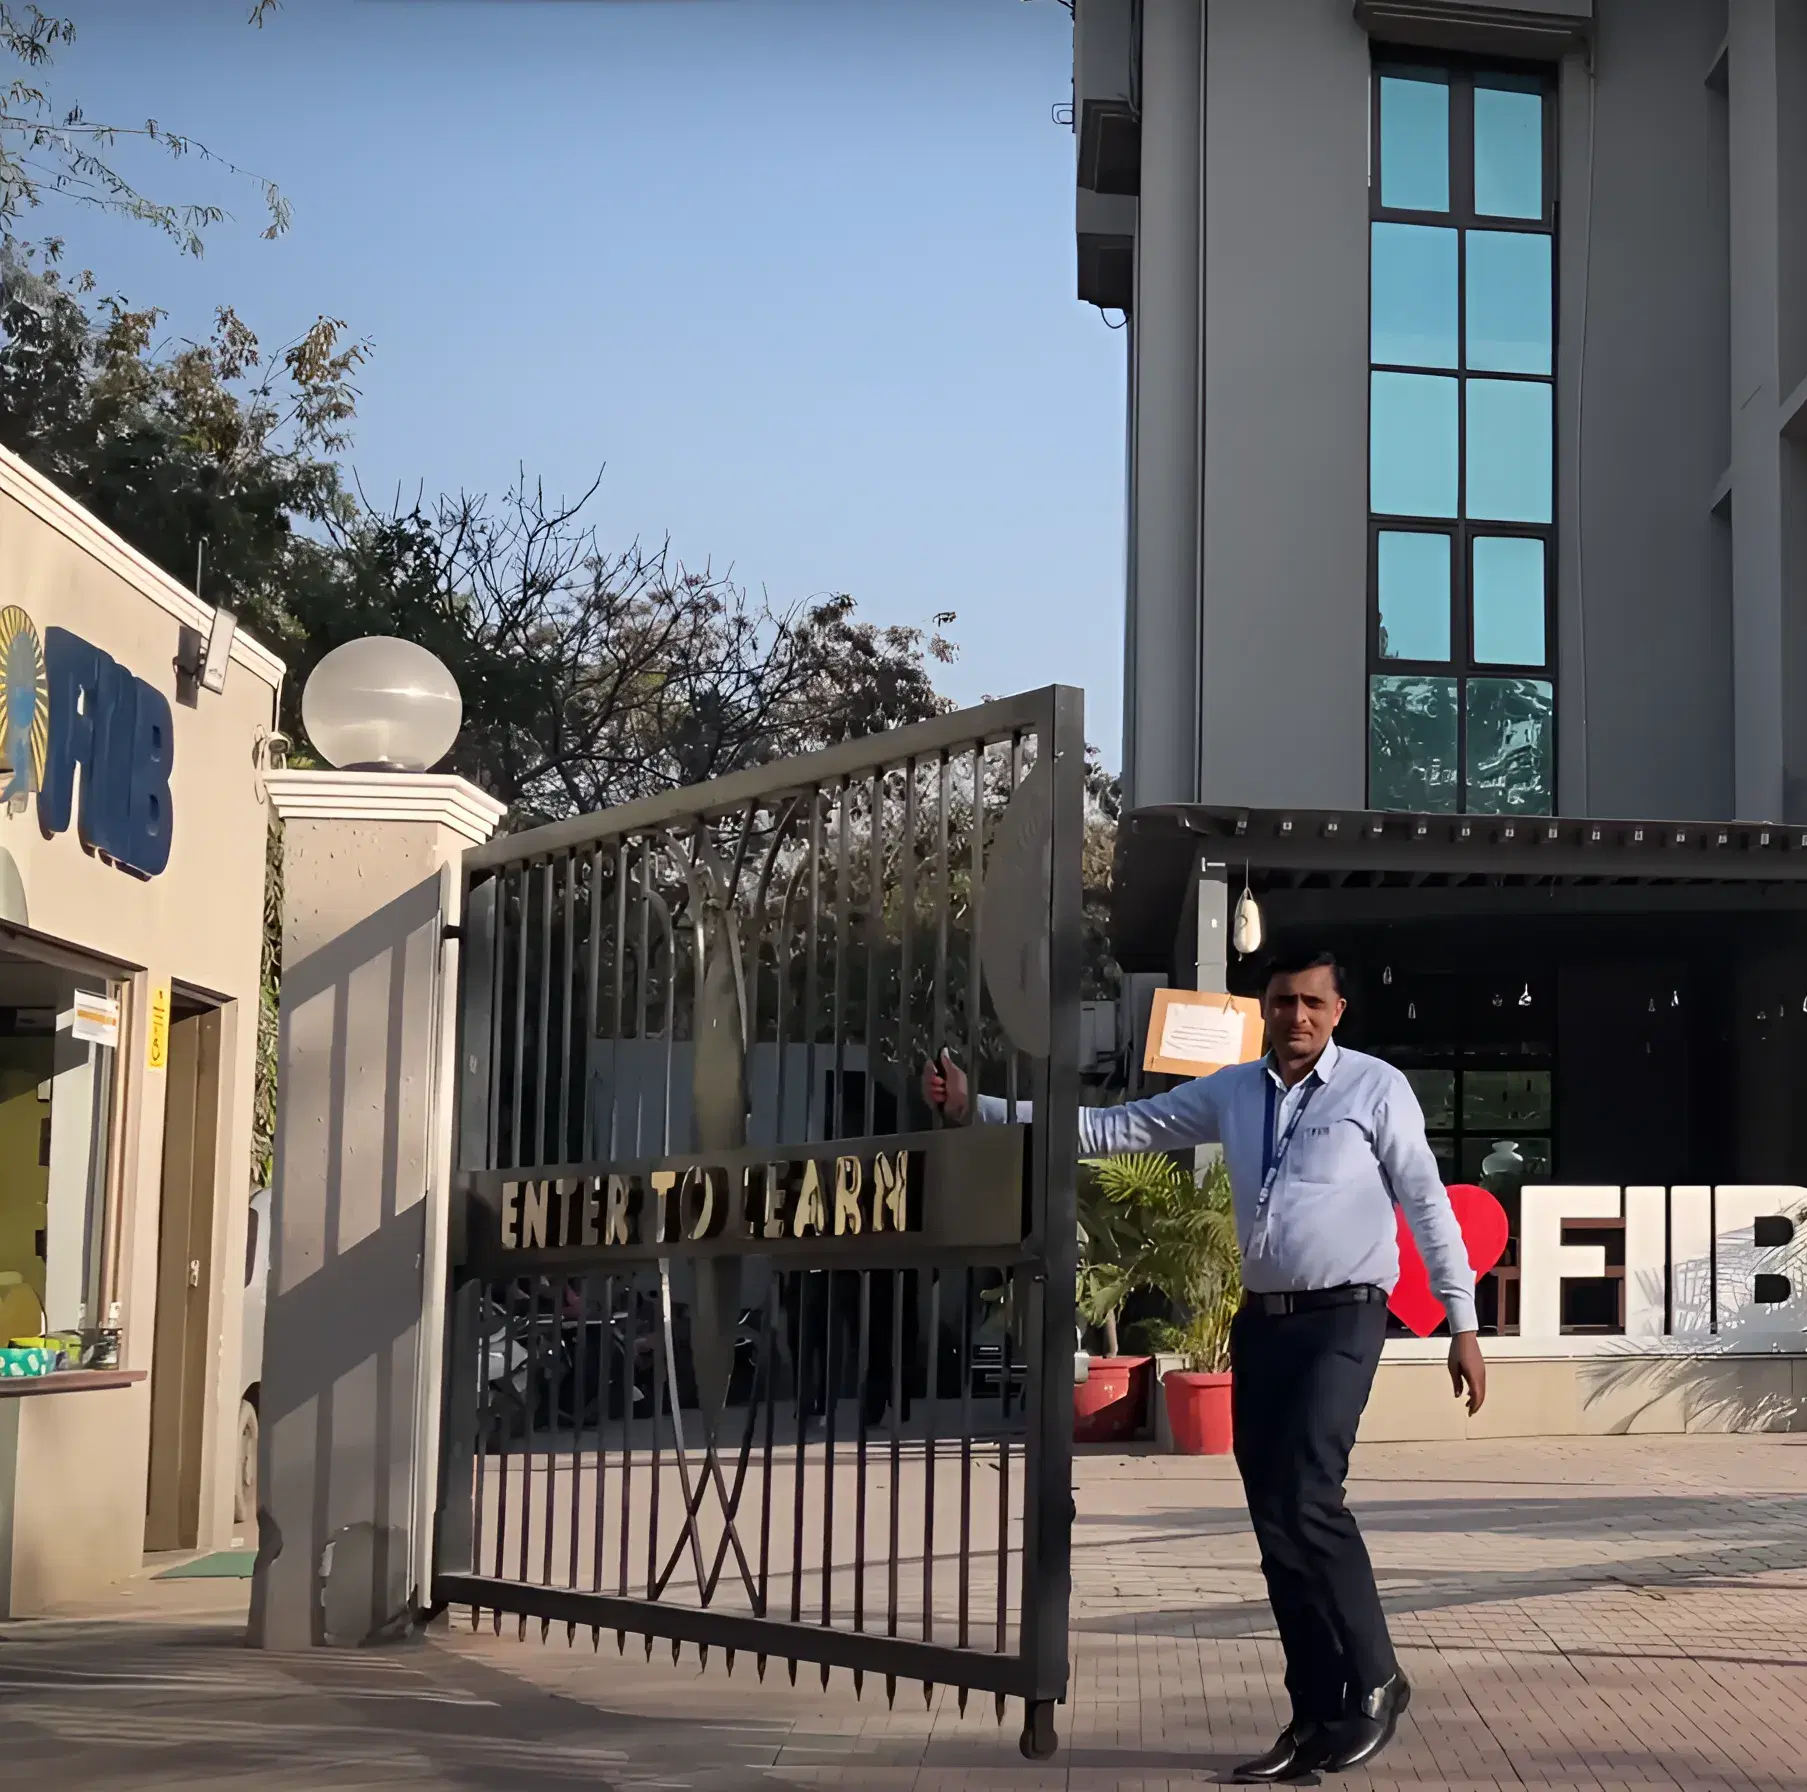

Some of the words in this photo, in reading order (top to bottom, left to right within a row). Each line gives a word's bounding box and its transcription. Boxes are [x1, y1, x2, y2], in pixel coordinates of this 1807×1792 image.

[501, 1175, 632, 1249] ENTER
[650, 1164, 716, 1245] TO
[740, 1150, 911, 1241] LEARN
